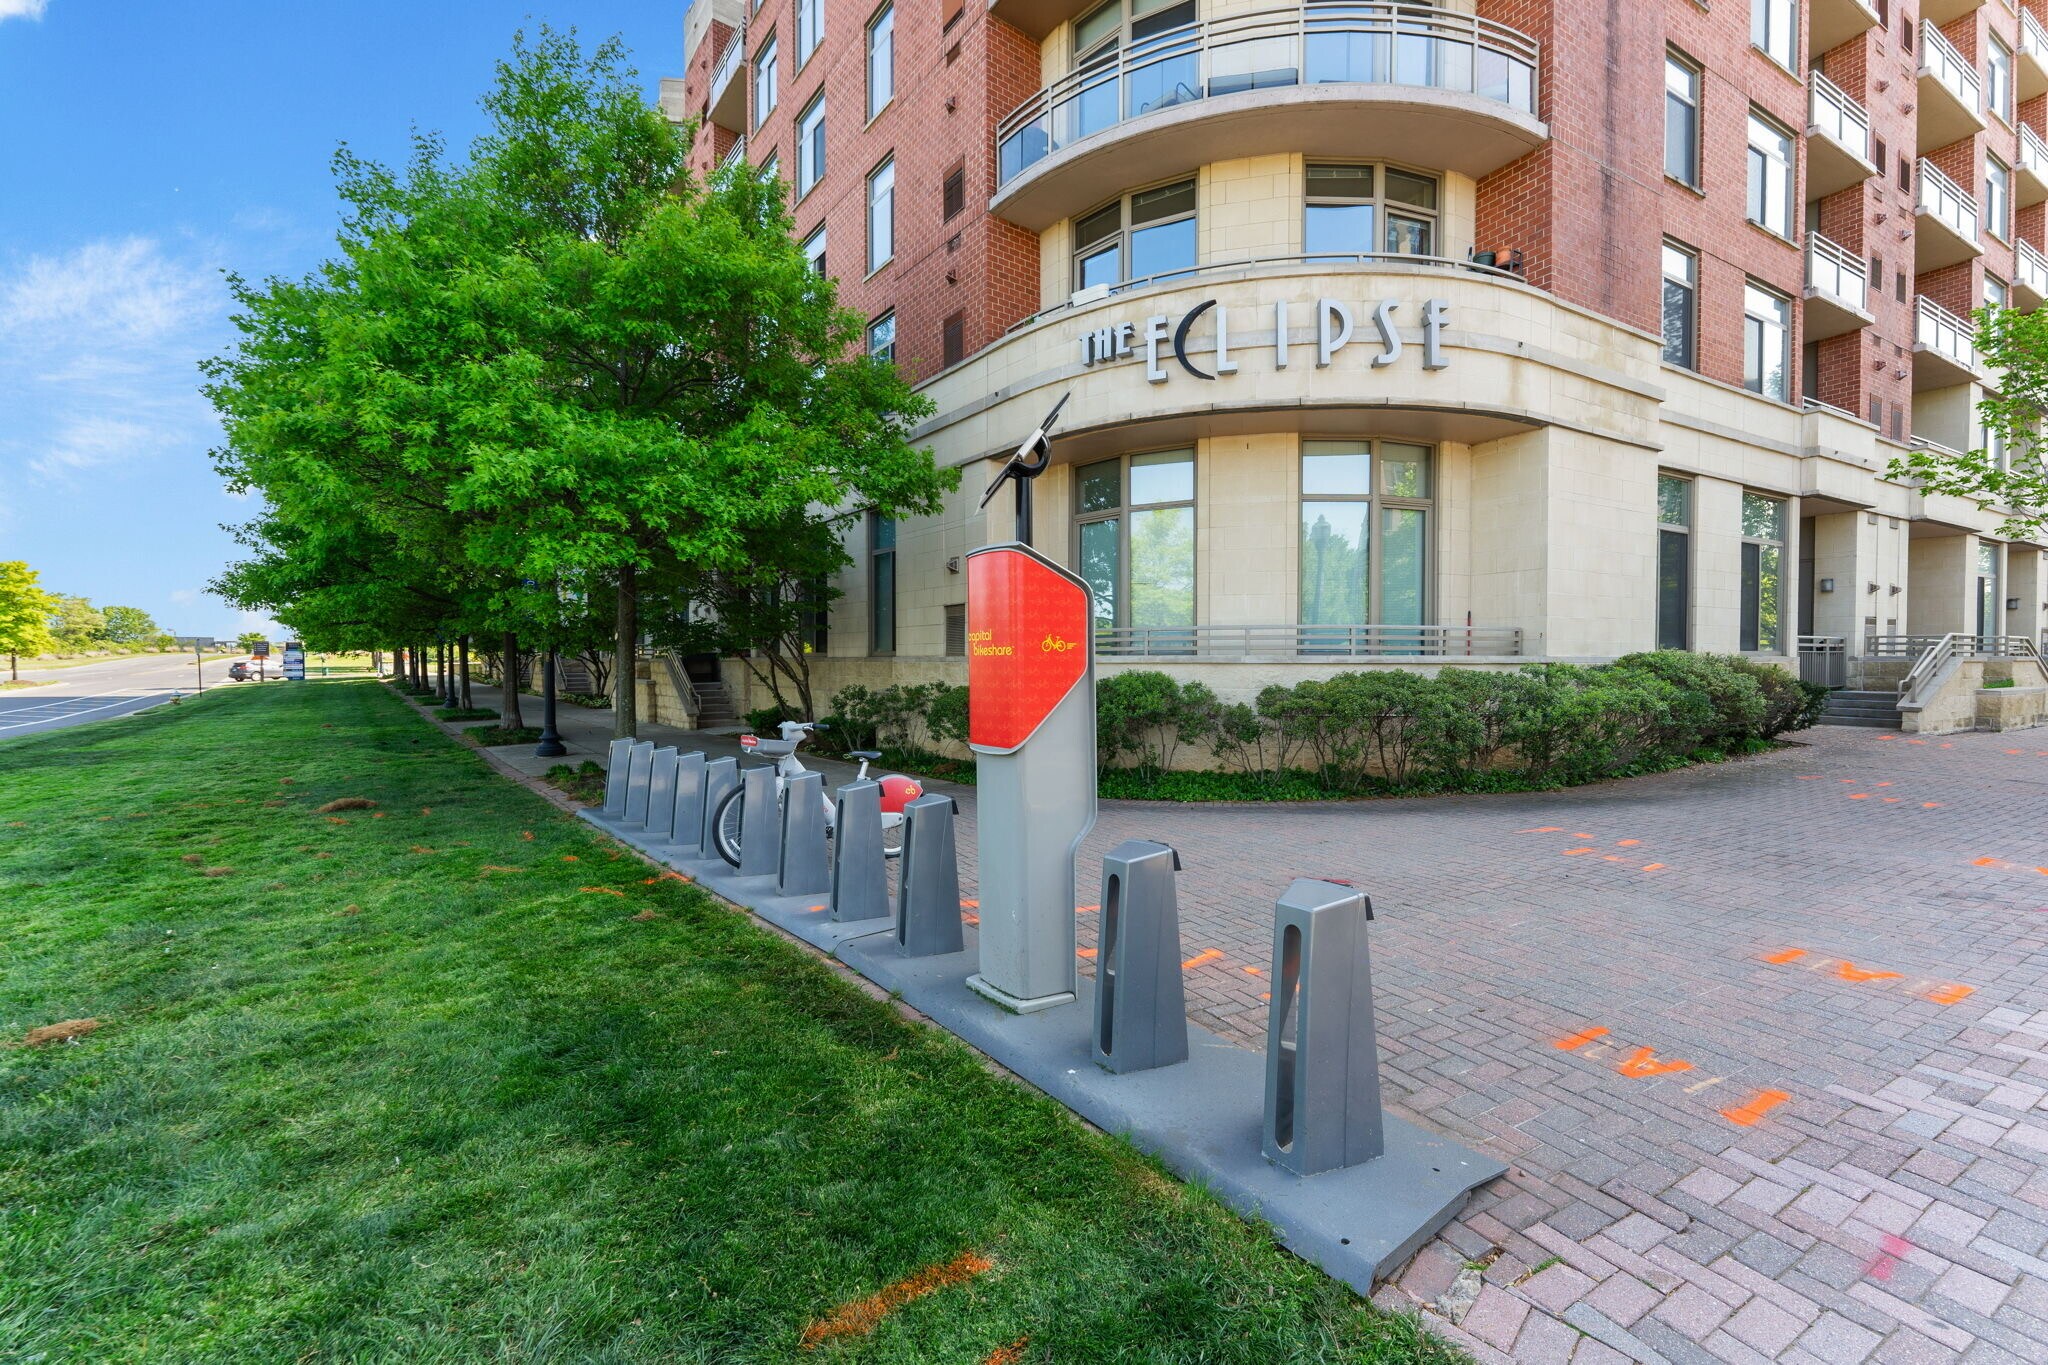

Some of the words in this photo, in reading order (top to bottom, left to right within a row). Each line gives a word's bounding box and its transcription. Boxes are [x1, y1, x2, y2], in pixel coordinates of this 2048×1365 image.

[1079, 321, 1135, 368] THE
[1143, 299, 1449, 385] ECLIPSE
[973, 643, 1013, 656] bikeshare
